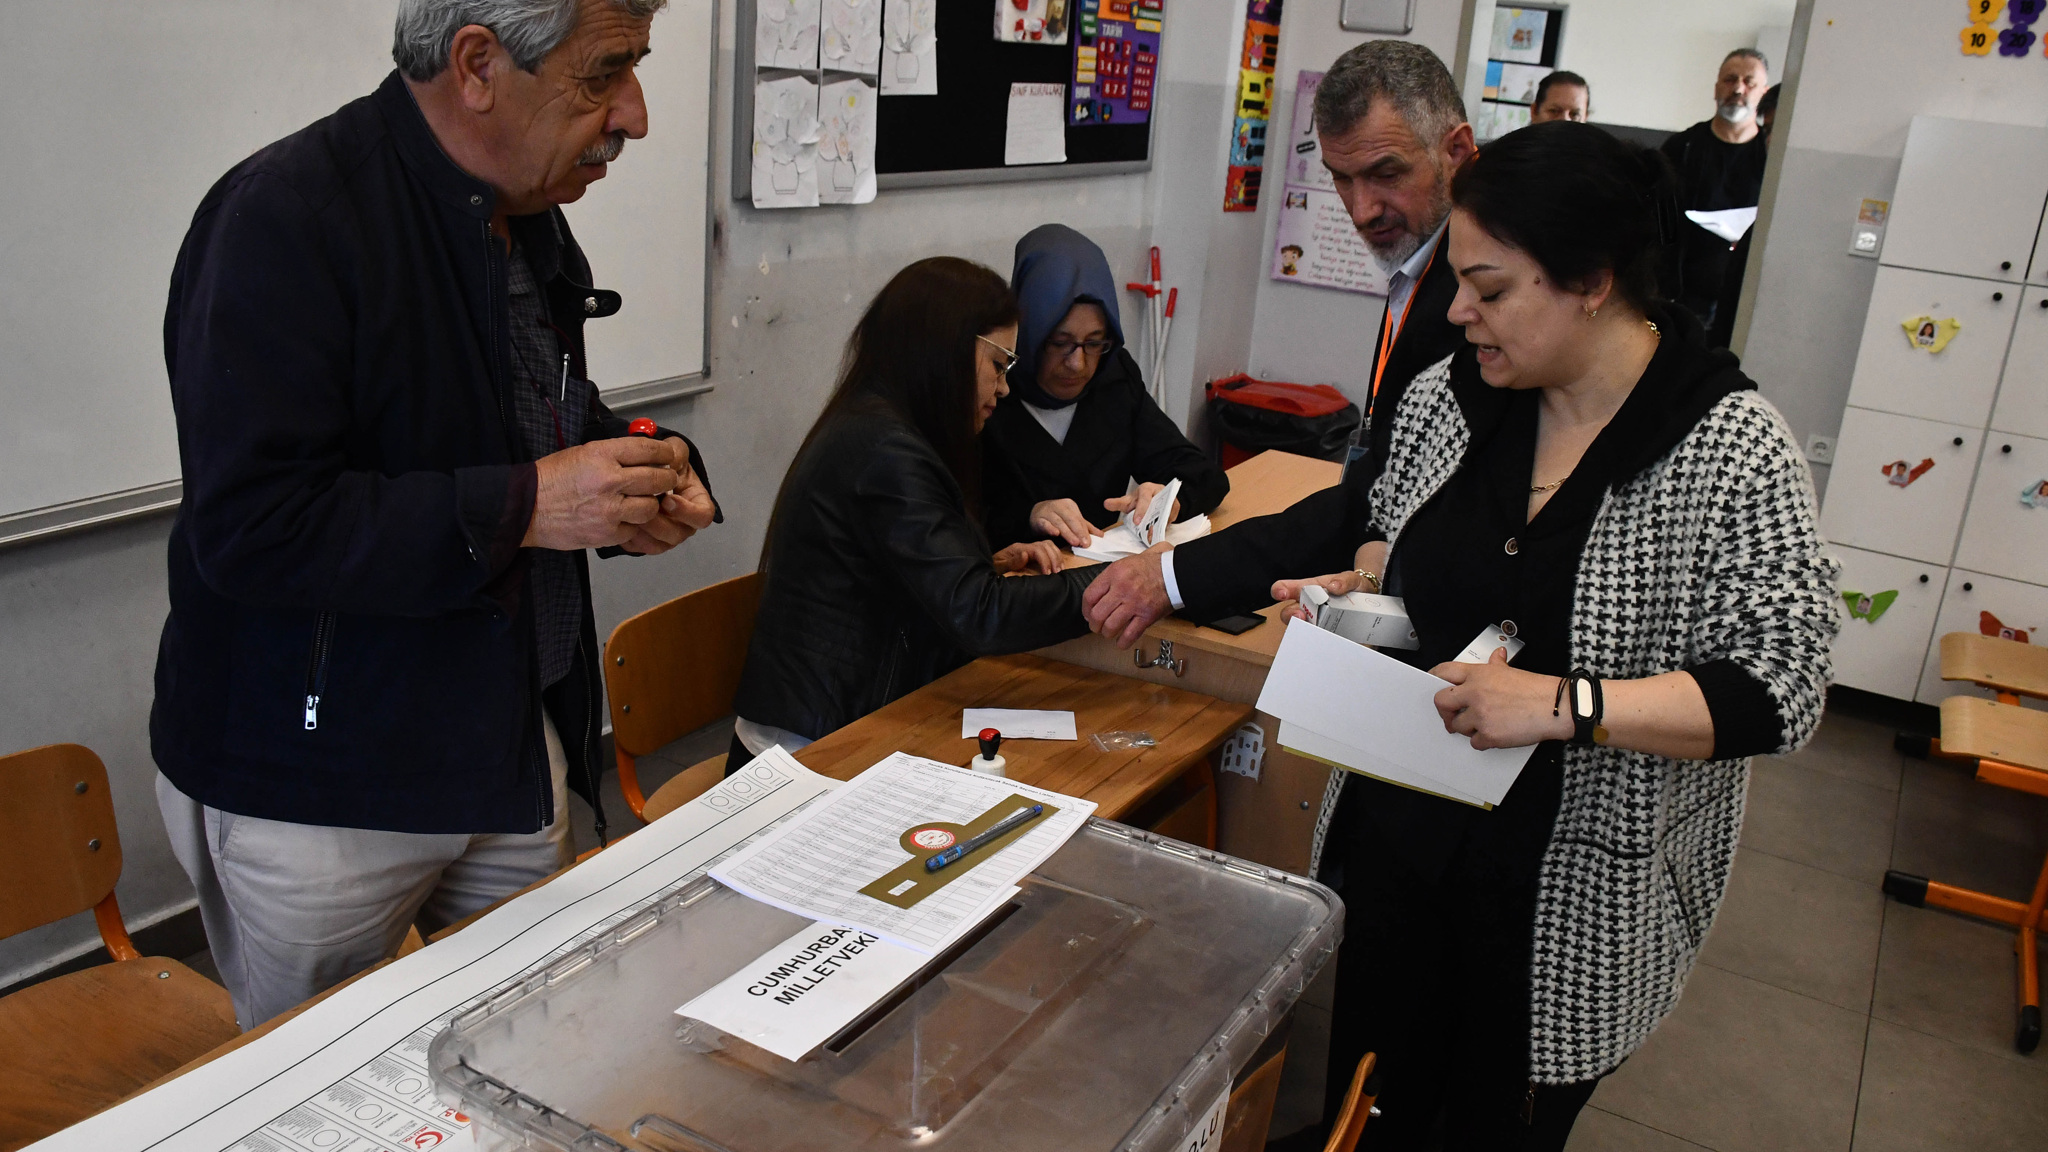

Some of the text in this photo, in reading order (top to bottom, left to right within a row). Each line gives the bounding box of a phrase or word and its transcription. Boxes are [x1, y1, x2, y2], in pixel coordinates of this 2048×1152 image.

[1980, 0, 1991, 14] 9
[1971, 32, 2028, 48] 10 20
[747, 925, 854, 996] CUMHURBA
[773, 931, 880, 1006] MİLLETVEKİ
